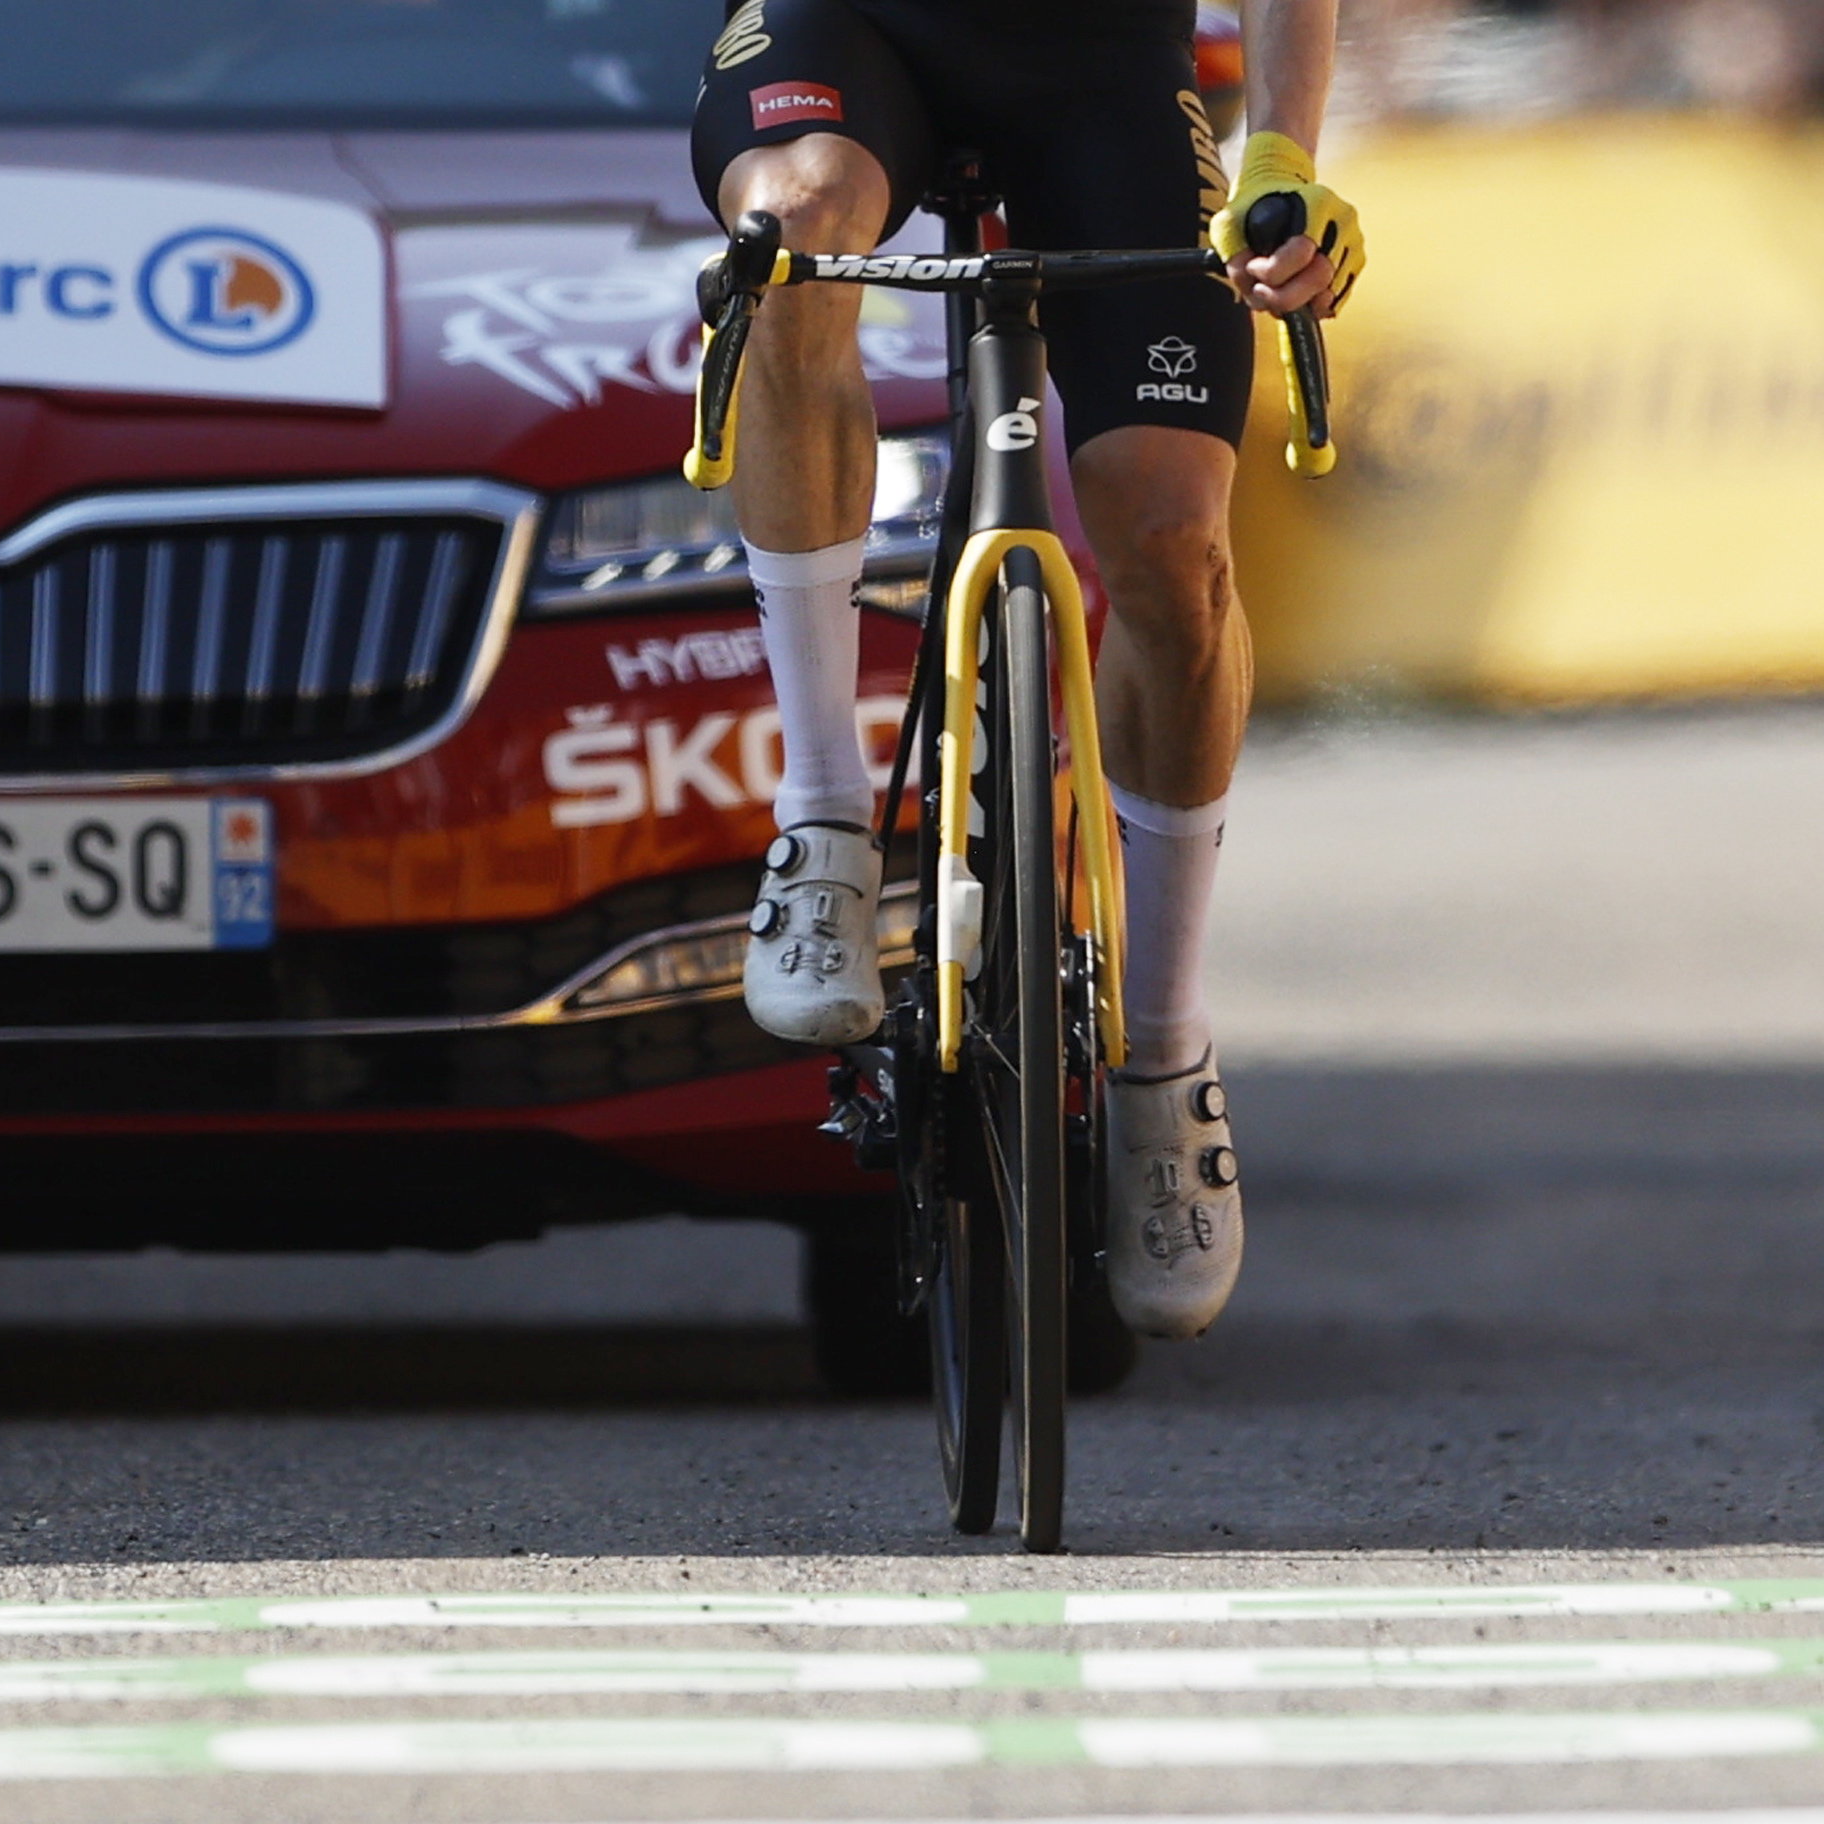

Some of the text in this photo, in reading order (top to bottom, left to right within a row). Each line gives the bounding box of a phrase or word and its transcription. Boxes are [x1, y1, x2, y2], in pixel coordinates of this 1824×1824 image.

[758, 94, 834, 114] HEMA
[992, 260, 1033, 270] GARMIN
[1136, 383, 1208, 404] AGU
